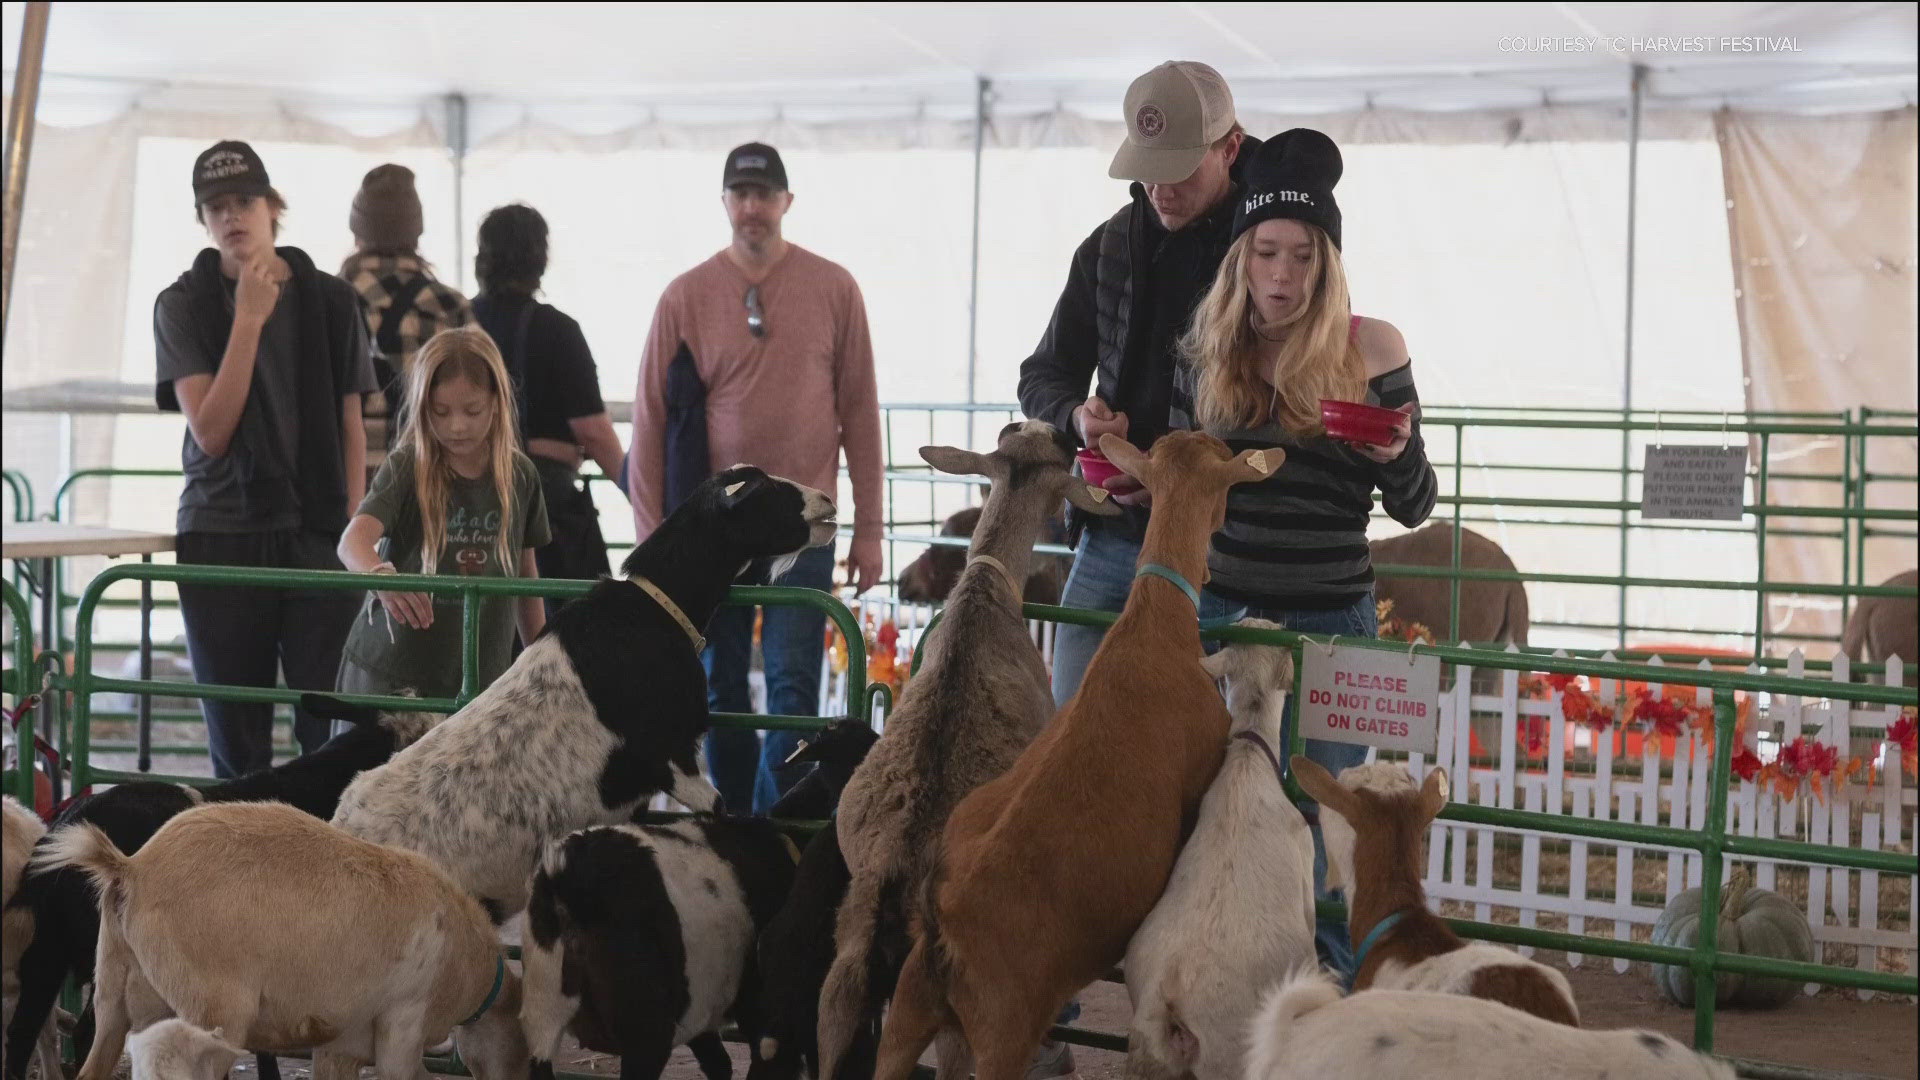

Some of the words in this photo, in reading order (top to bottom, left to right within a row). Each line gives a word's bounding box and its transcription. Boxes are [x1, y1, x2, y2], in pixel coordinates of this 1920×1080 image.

[1245, 192, 1274, 214] bite
[1280, 190, 1315, 206] me.
[1663, 459, 1685, 469] AND
[1653, 471, 1692, 482] PLEASE
[1695, 472, 1711, 482] DO
[1713, 473, 1735, 484] NOT
[1666, 485, 1695, 494] YOUR
[1650, 497, 1661, 506] IN
[1664, 497, 1684, 506] THE
[1334, 671, 1408, 694] PLEASE
[1309, 689, 1332, 706] DO
[1336, 692, 1371, 711] NOT
[1375, 697, 1427, 718] CLIMB
[1326, 712, 1351, 730] ON
[1355, 716, 1409, 738] GATES
